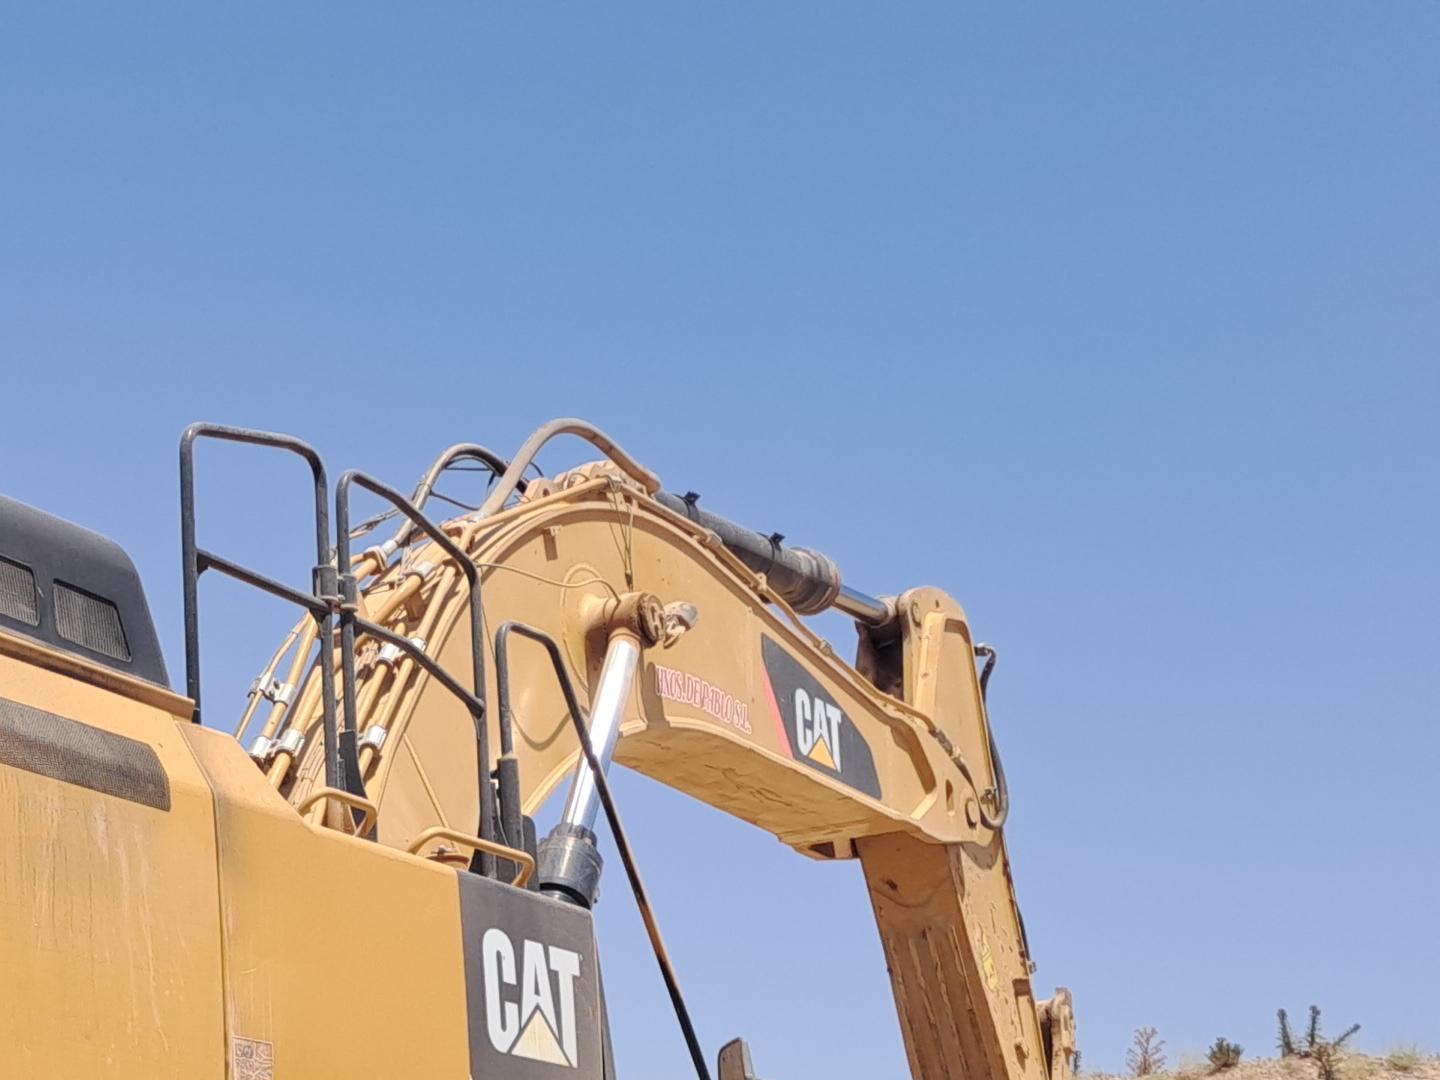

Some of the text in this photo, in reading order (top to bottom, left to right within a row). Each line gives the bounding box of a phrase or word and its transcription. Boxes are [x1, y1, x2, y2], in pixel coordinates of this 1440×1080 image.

[685, 673, 700, 708] DE
[700, 680, 733, 724] PABLO
[795, 688, 842, 773] CAT
[482, 928, 581, 1068] CAT
